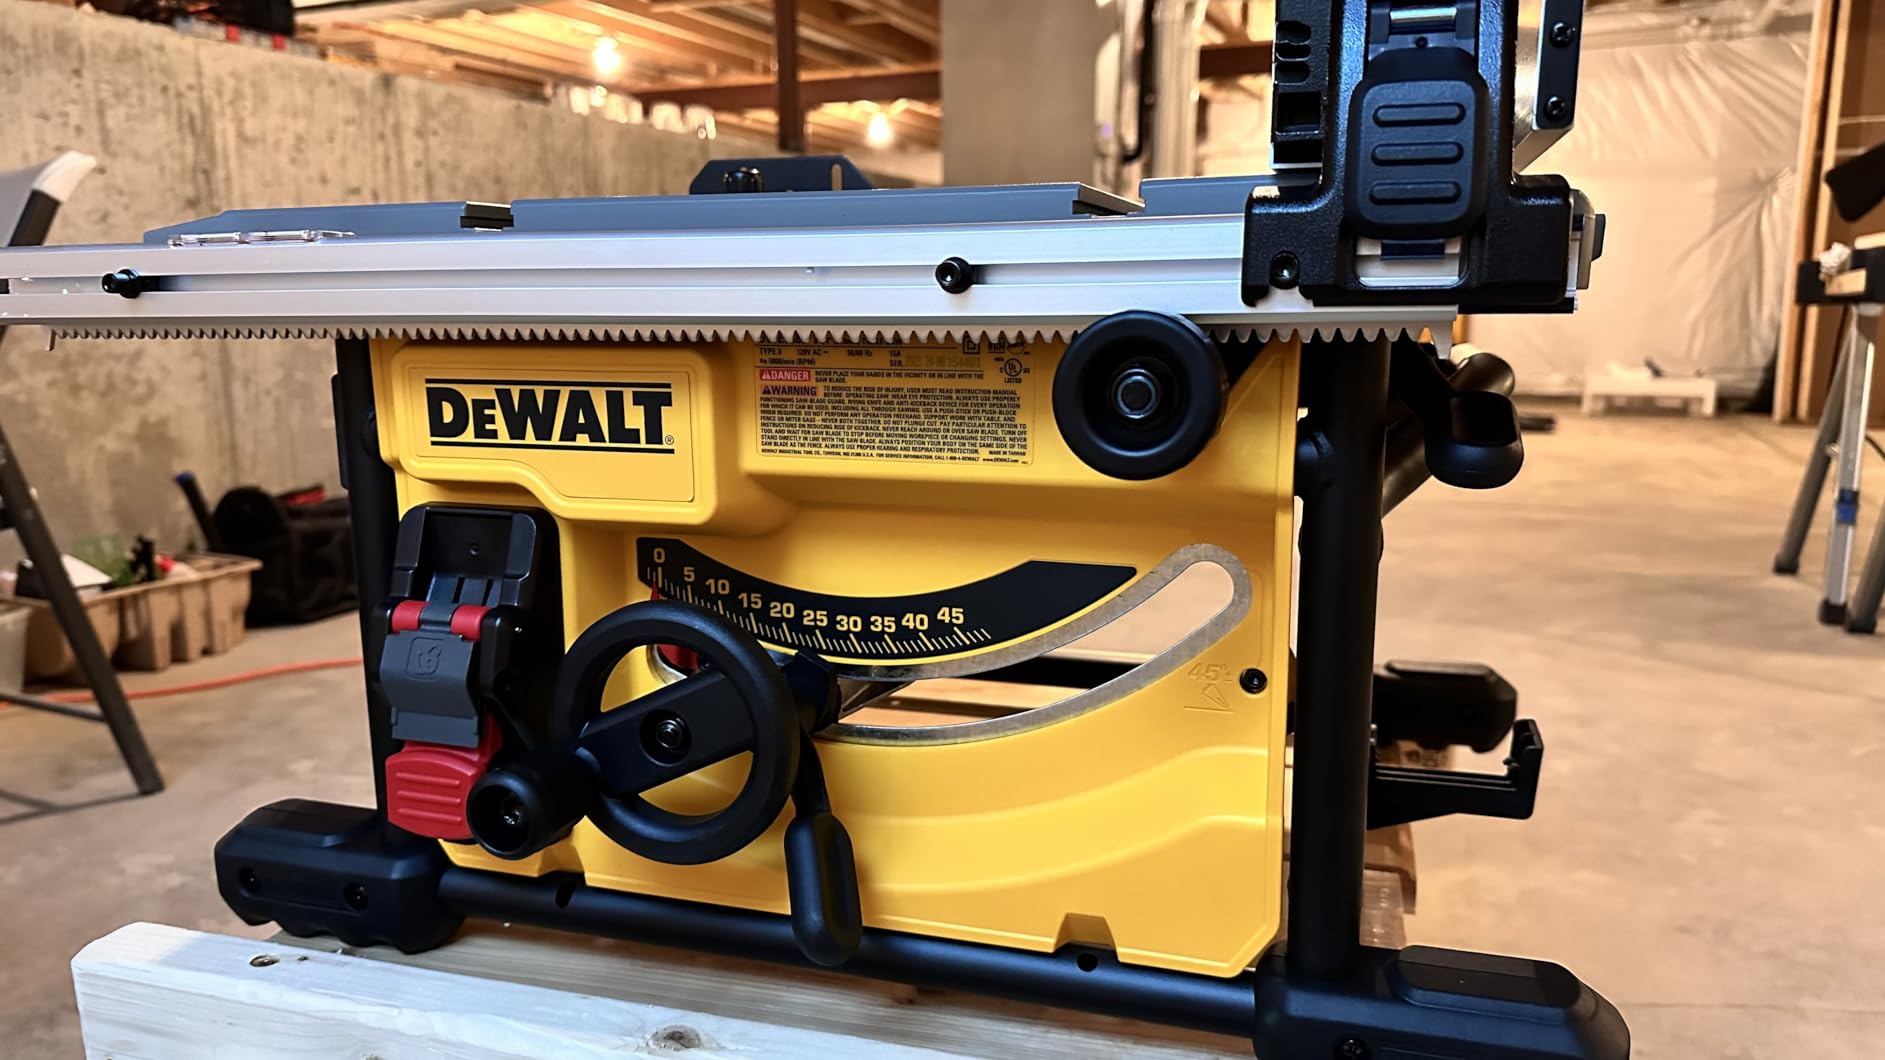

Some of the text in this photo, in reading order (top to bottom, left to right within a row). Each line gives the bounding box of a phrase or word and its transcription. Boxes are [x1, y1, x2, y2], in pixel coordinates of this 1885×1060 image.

[796, 358, 816, 366] (RPM)
[771, 370, 809, 380] DANGER
[771, 386, 817, 396] WARNING
[653, 548, 964, 633] 0 5 10 15 20 25 30 35 40 45
